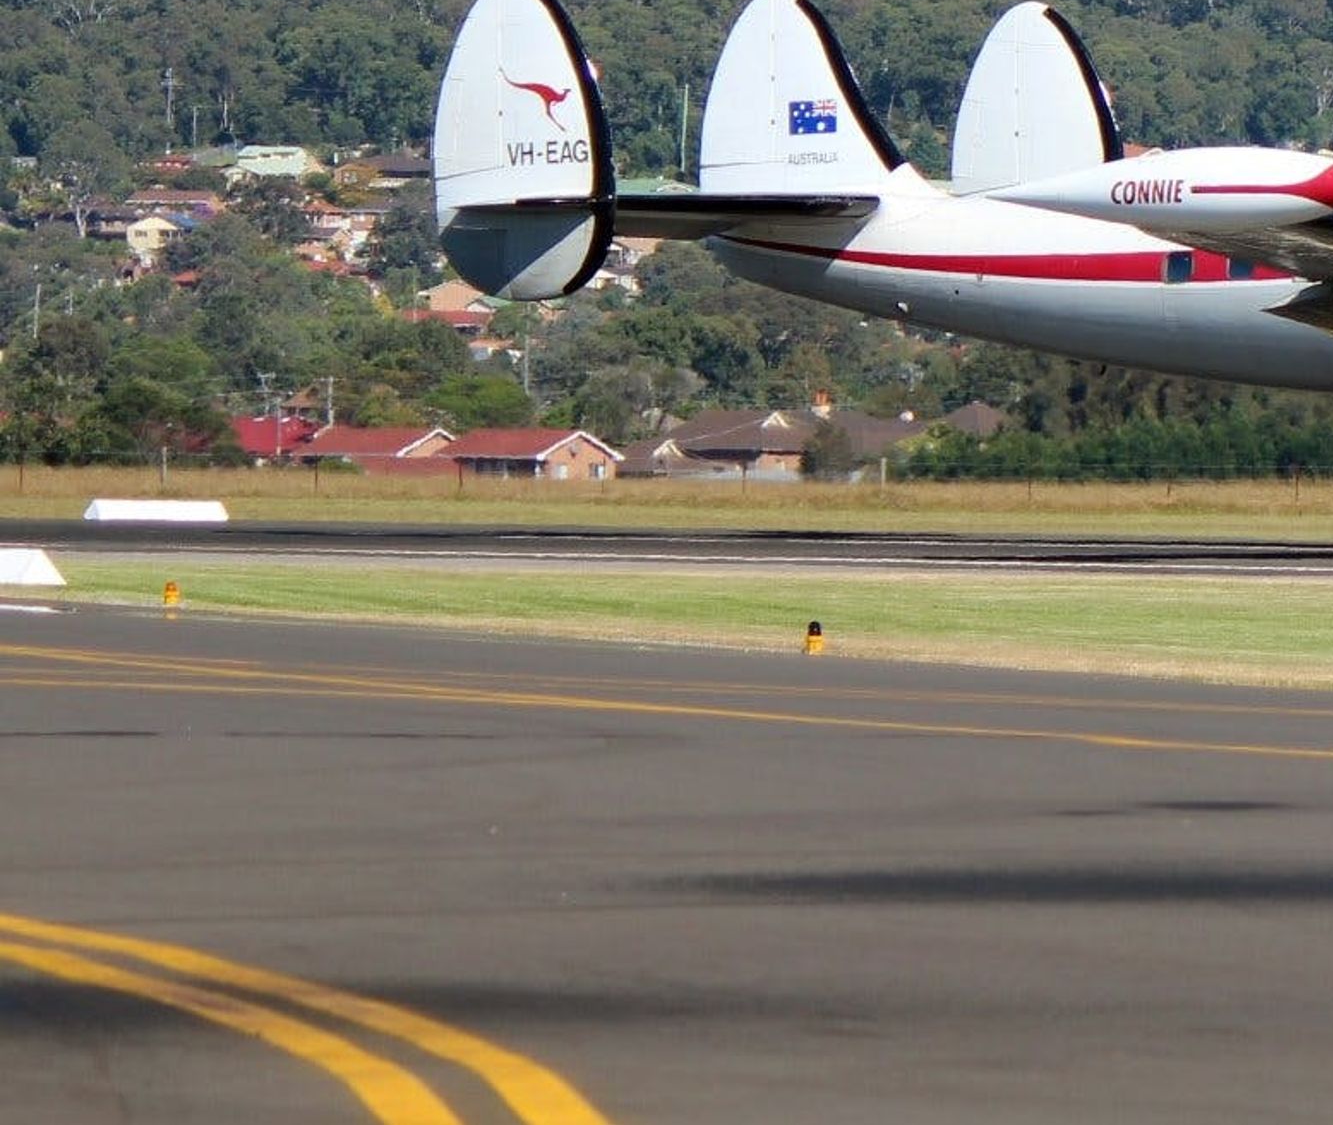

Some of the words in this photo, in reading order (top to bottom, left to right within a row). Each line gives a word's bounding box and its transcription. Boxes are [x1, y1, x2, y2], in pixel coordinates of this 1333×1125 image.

[507, 139, 589, 167] VH-EAG
[787, 151, 839, 165] AUSTRALIA
[1110, 179, 1185, 205] CONNIE
